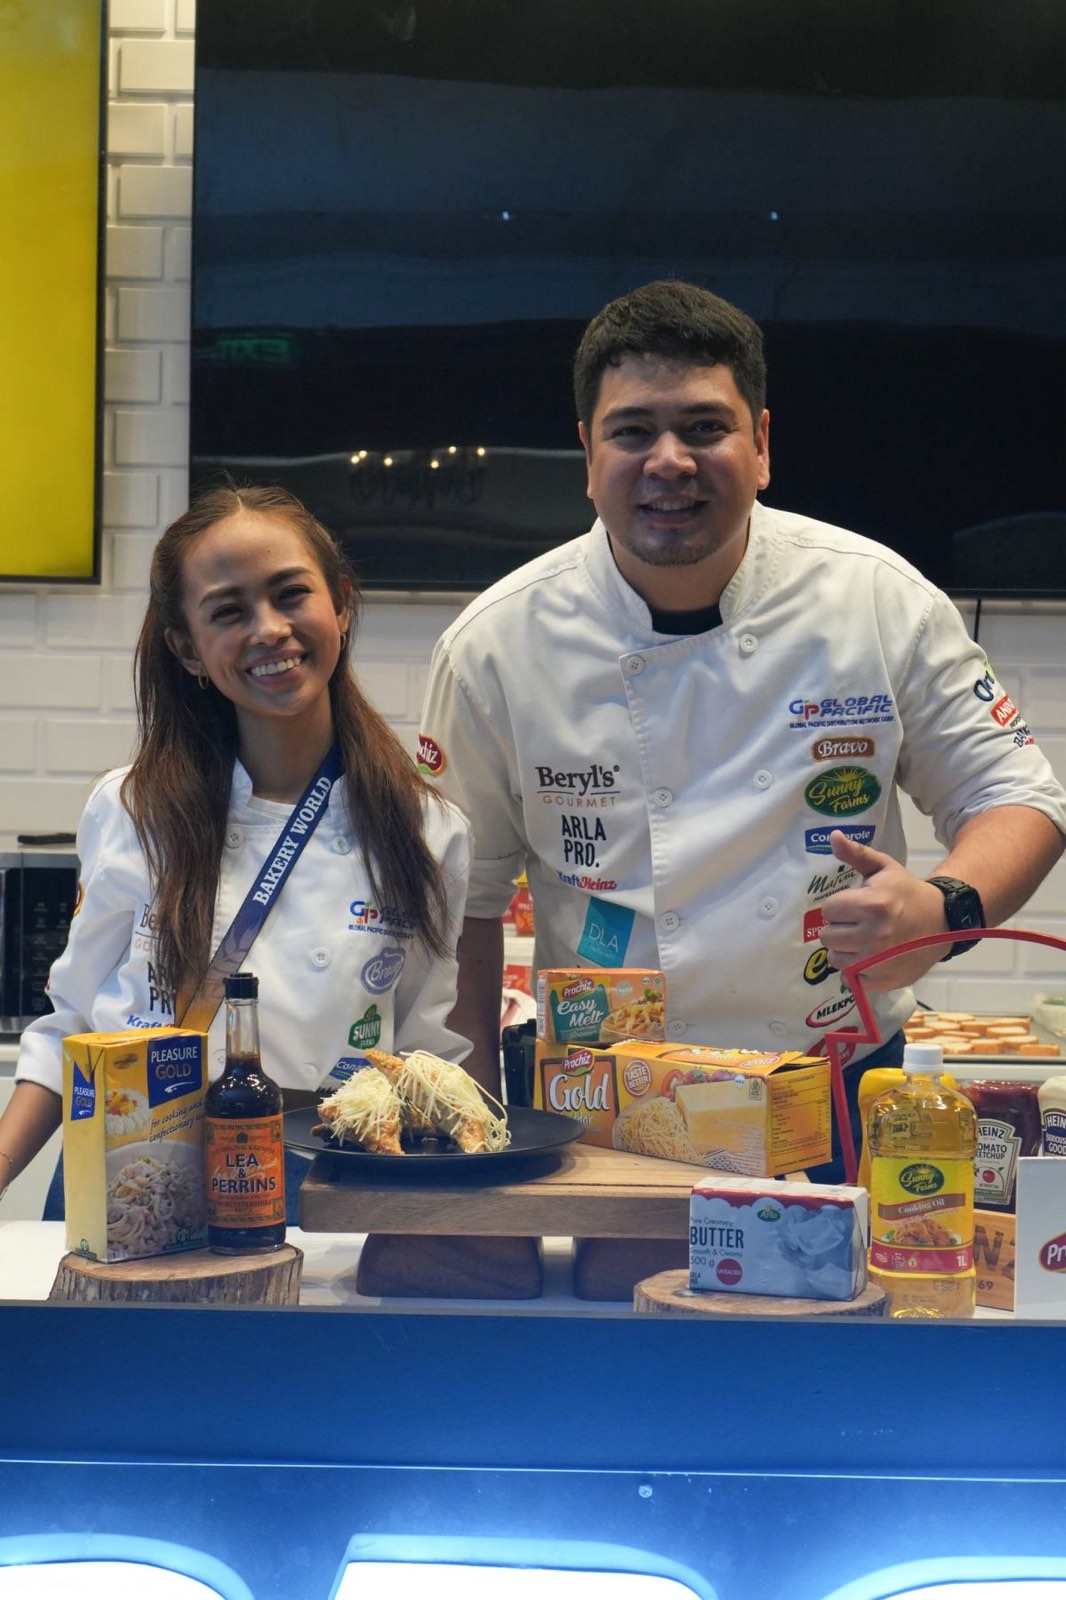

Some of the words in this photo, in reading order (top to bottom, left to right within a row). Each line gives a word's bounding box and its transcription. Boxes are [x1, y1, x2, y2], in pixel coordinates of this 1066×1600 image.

[821, 695, 893, 708] GLOBAL
[820, 704, 892, 717] PACIFIC
[818, 741, 868, 757] Bravo
[809, 779, 864, 806] Sunny
[542, 795, 616, 808] GOURMET
[829, 795, 869, 813] Farms
[561, 814, 607, 841] ARLA
[252, 835, 300, 906] BAKERY
[290, 776, 332, 836] WORLD
[588, 923, 619, 953] DLA
[564, 981, 592, 998] Prochiz
[569, 1010, 604, 1028] Melt
[151, 1046, 199, 1063] PLEASURE
[564, 1052, 592, 1070] Prochiz
[156, 1063, 192, 1080] GOLD
[626, 1067, 648, 1080] TASTE
[550, 1072, 610, 1111] Gold
[226, 1152, 259, 1168] LEA
[238, 1169, 247, 1179] &
[901, 1170, 934, 1187] Sunny
[212, 1177, 277, 1193] PERRINS
[913, 1182, 937, 1192] Farms
[898, 1200, 932, 1214] Cooking
[932, 1197, 945, 1207] Oil
[690, 1226, 744, 1249] BUTTER
